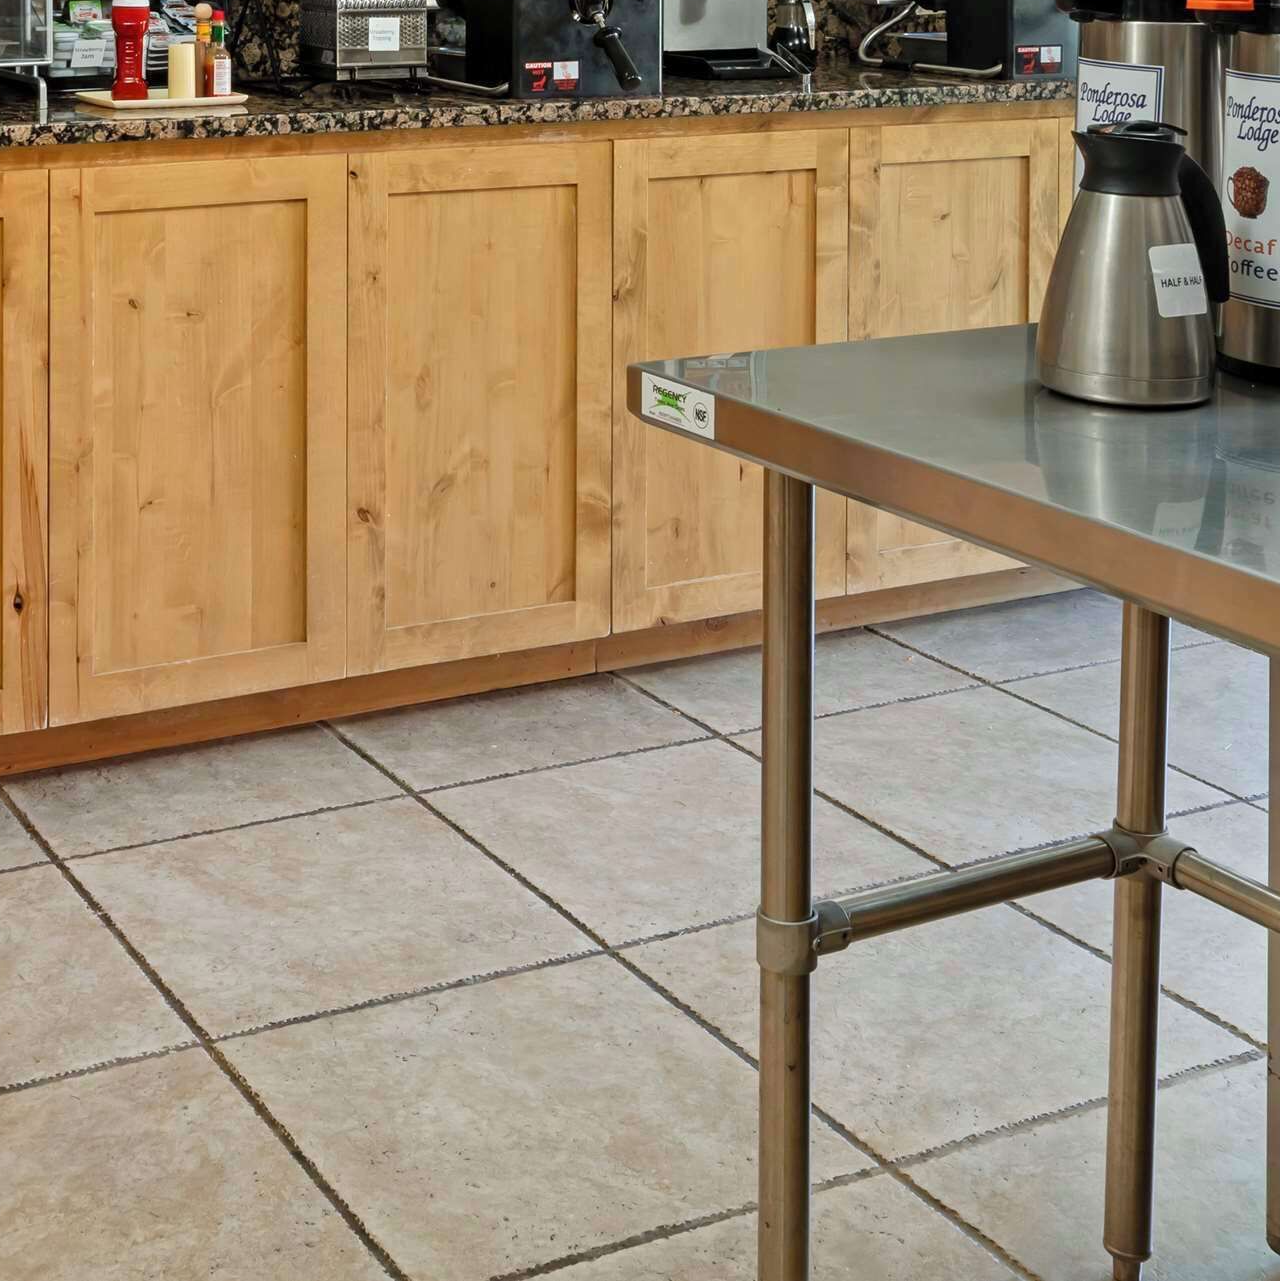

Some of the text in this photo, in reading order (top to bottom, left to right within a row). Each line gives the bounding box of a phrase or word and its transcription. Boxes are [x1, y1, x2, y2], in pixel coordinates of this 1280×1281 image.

[525, 62, 553, 70] CAUTION
[1080, 81, 1147, 109] Ponderosa
[1237, 120, 1279, 151] Lodge
[1225, 230, 1278, 255] Decaf
[1230, 259, 1279, 282] offee
[1161, 277, 1182, 288] HALF
[1183, 277, 1189, 286] &
[652, 384, 687, 404] REGENCY
[695, 408, 707, 422] NSF
